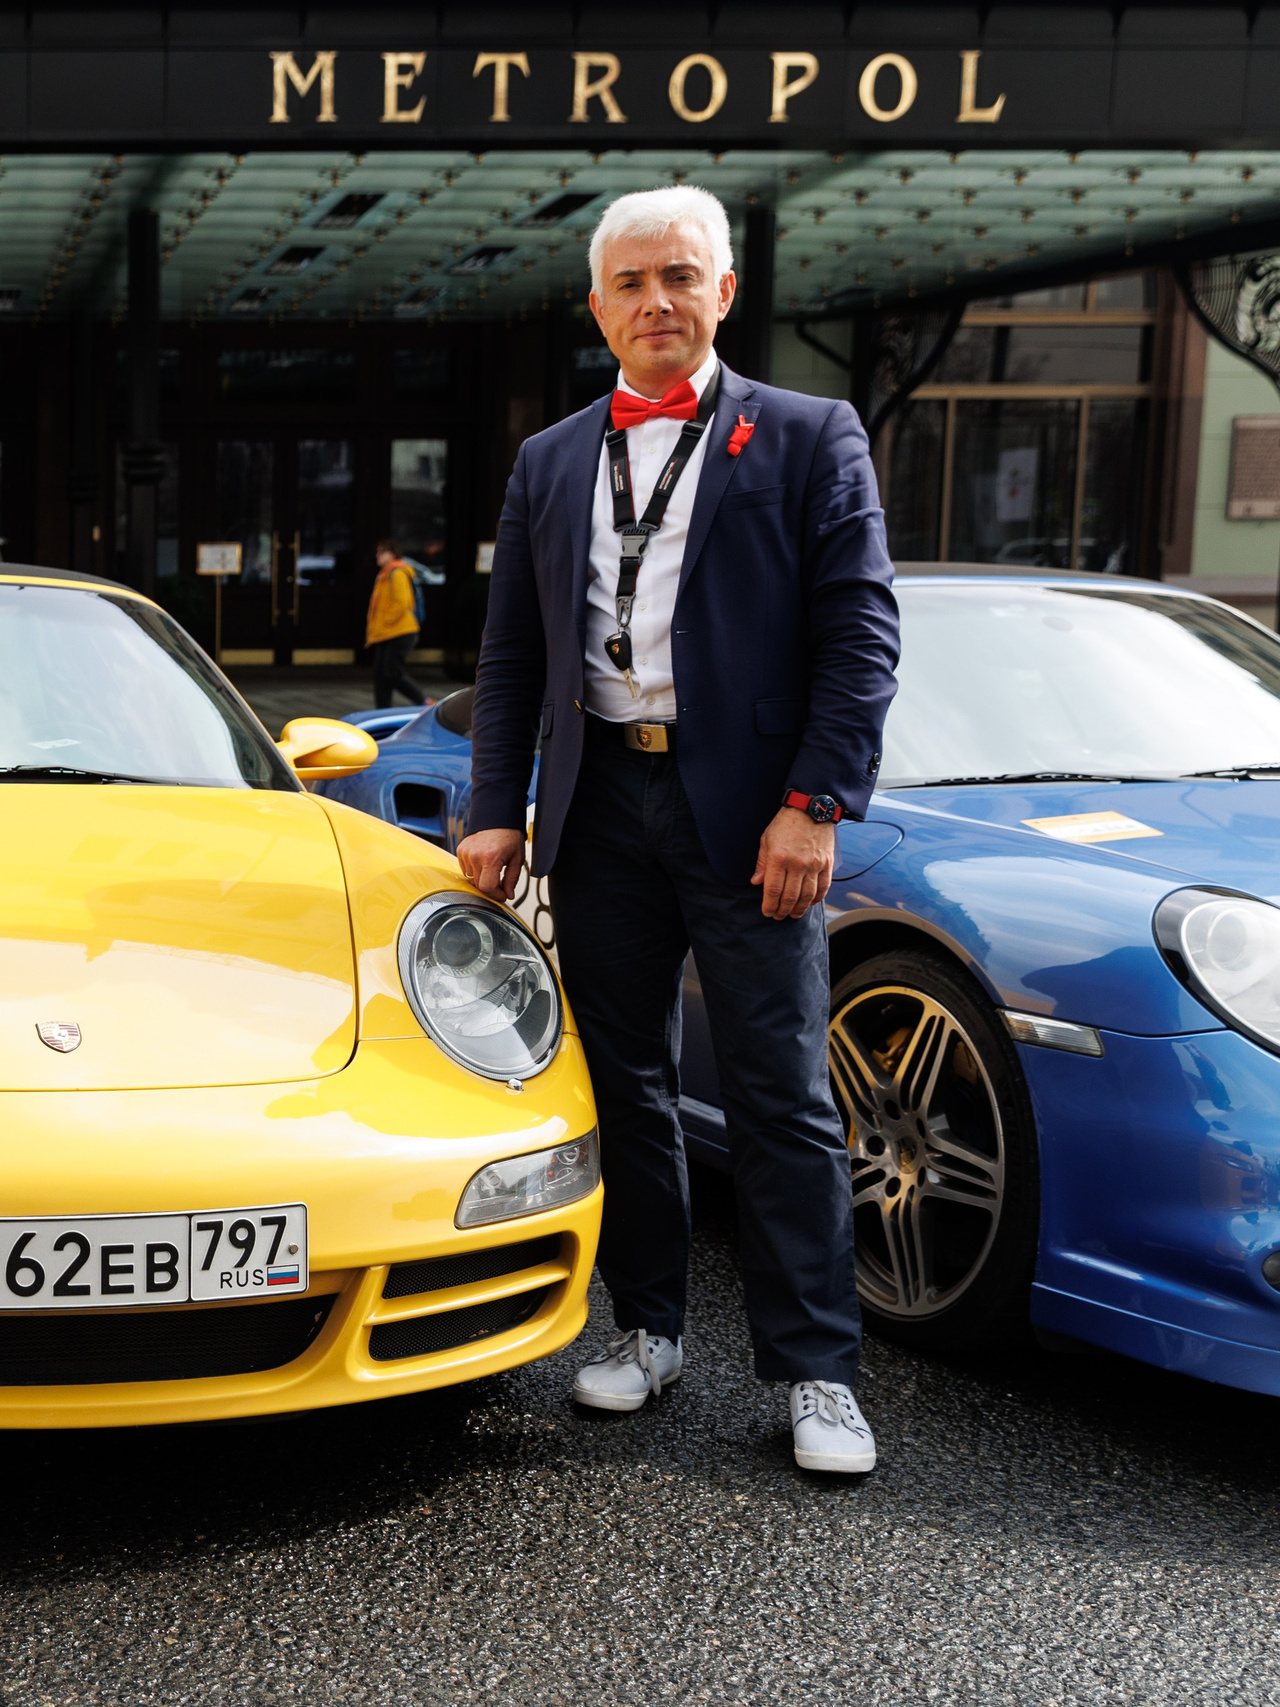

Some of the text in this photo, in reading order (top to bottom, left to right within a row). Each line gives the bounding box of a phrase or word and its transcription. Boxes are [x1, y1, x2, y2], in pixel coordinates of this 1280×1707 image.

[269, 50, 1006, 124] METROPOL
[196, 1215, 287, 1271] 797
[220, 1268, 265, 1290] RUS
